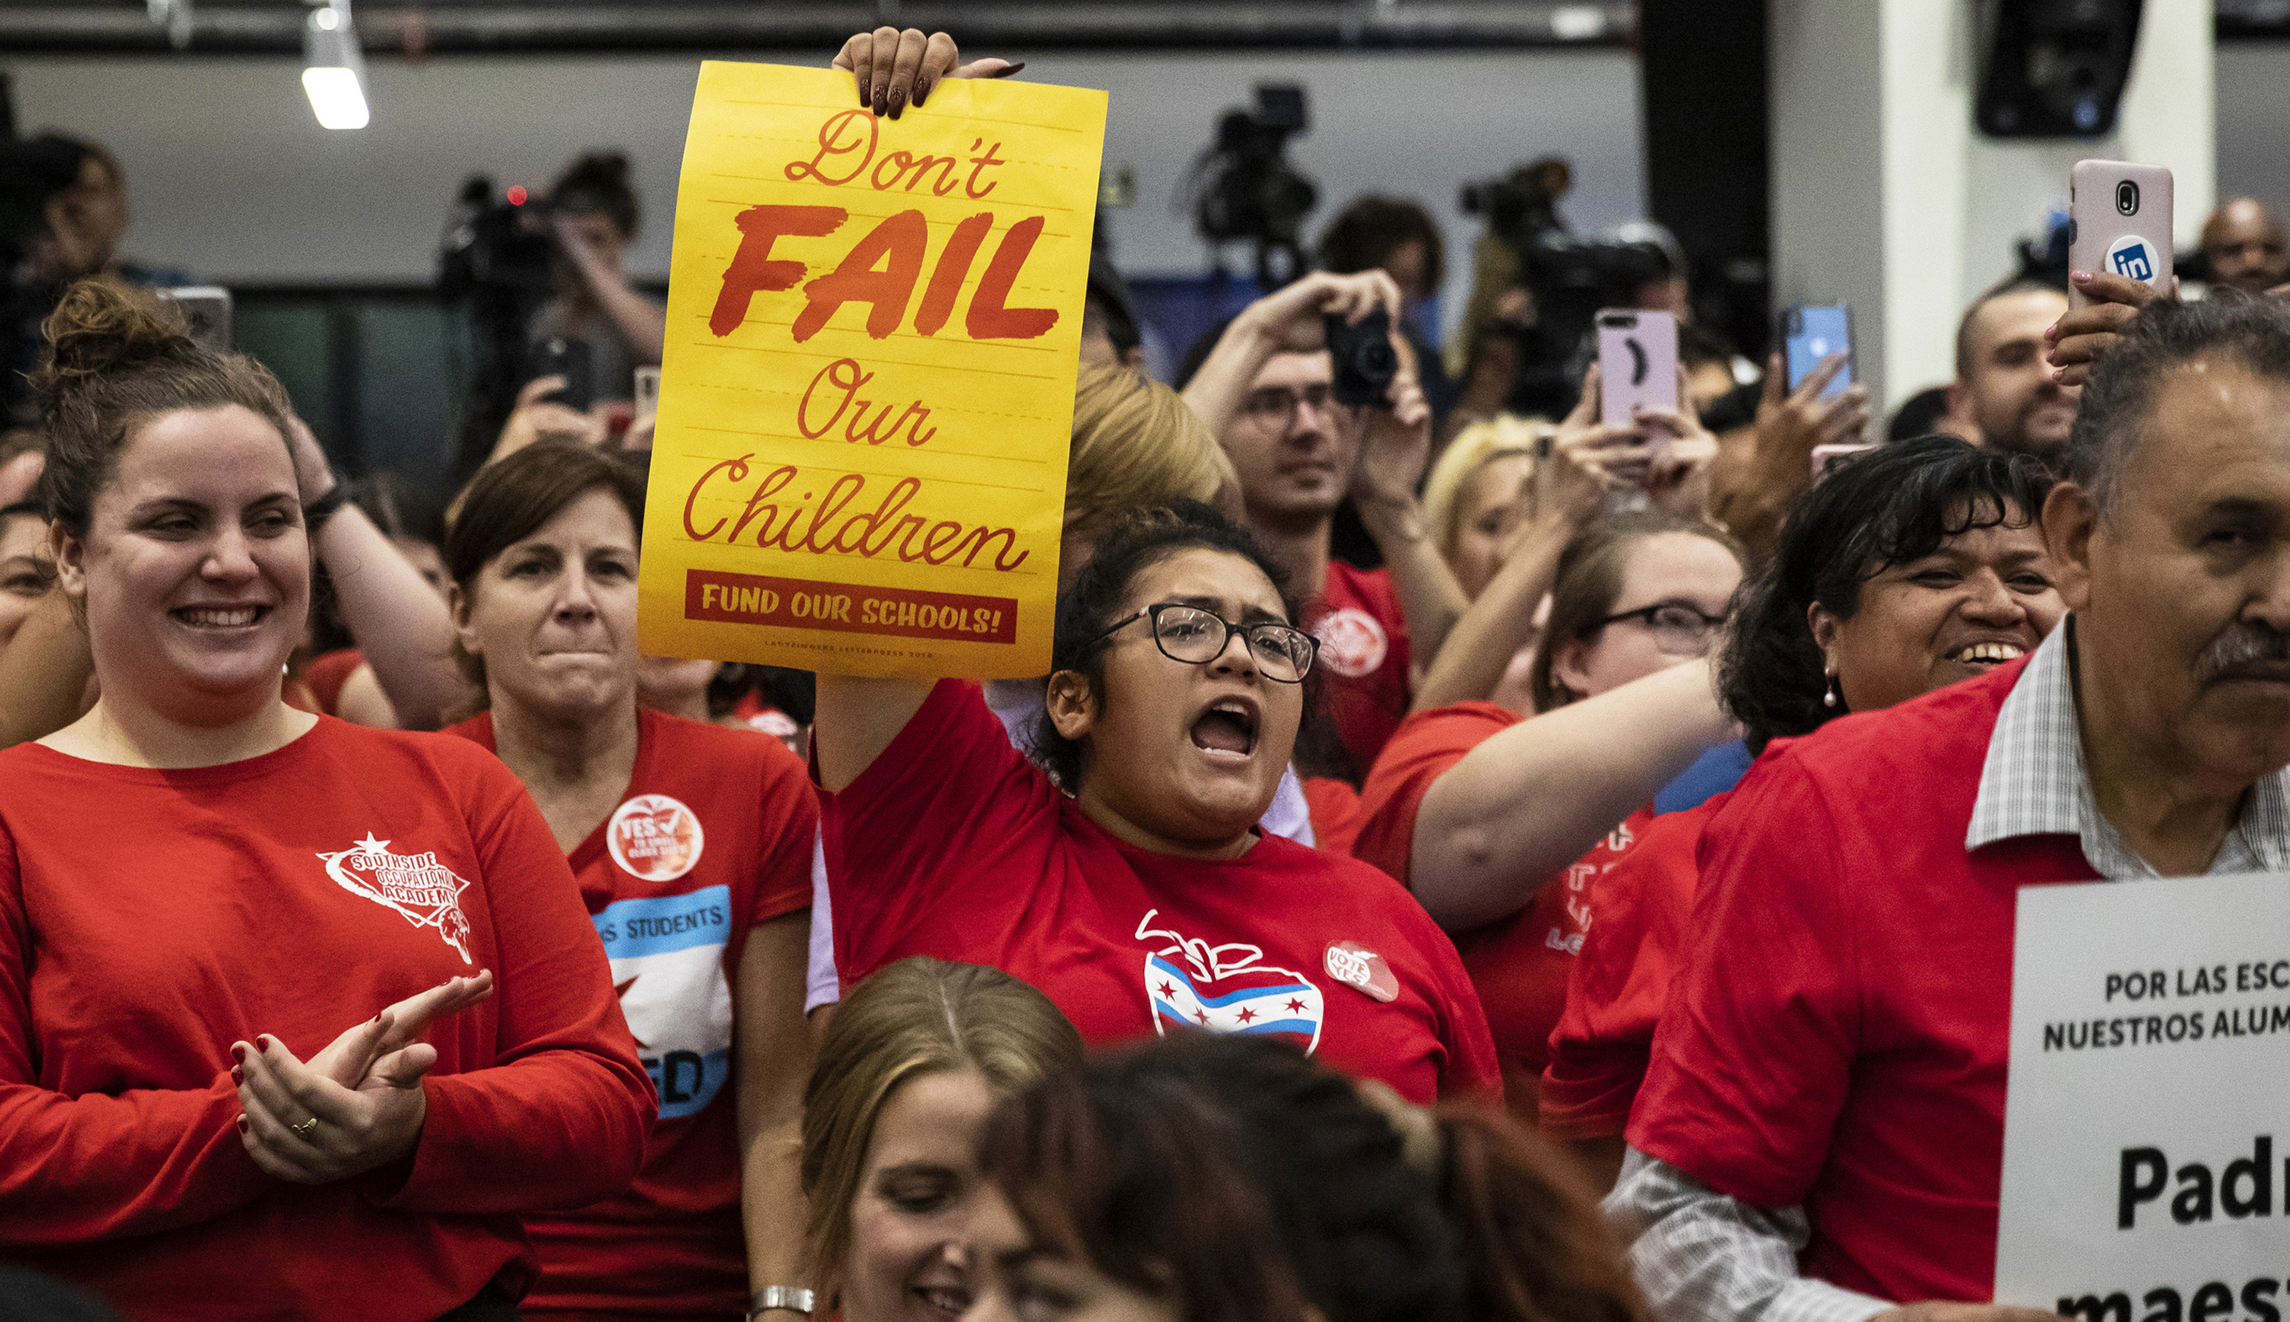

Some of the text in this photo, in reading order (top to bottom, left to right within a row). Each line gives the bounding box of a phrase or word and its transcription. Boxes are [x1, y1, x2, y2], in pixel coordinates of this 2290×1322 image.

[784, 109, 1006, 199] Don't
[709, 205, 1060, 343] FAIL
[797, 357, 937, 446] Our
[683, 453, 1030, 572] Children
[702, 584, 1001, 634] FUND OUR SCHOOLS!
[620, 817, 656, 839] YES
[351, 852, 437, 871] SOUTHSIDE
[376, 868, 456, 890] OCCUPATIONAL
[384, 886, 458, 905] ACADEMY
[626, 905, 723, 939] STUDENTS
[1329, 949, 1368, 977] VOTE
[1331, 961, 1363, 984] YES
[2105, 960, 2290, 1002] POR LAS ESC
[2043, 1010, 2205, 1053] NUESTROS
[2118, 1133, 2290, 1231] Pad
